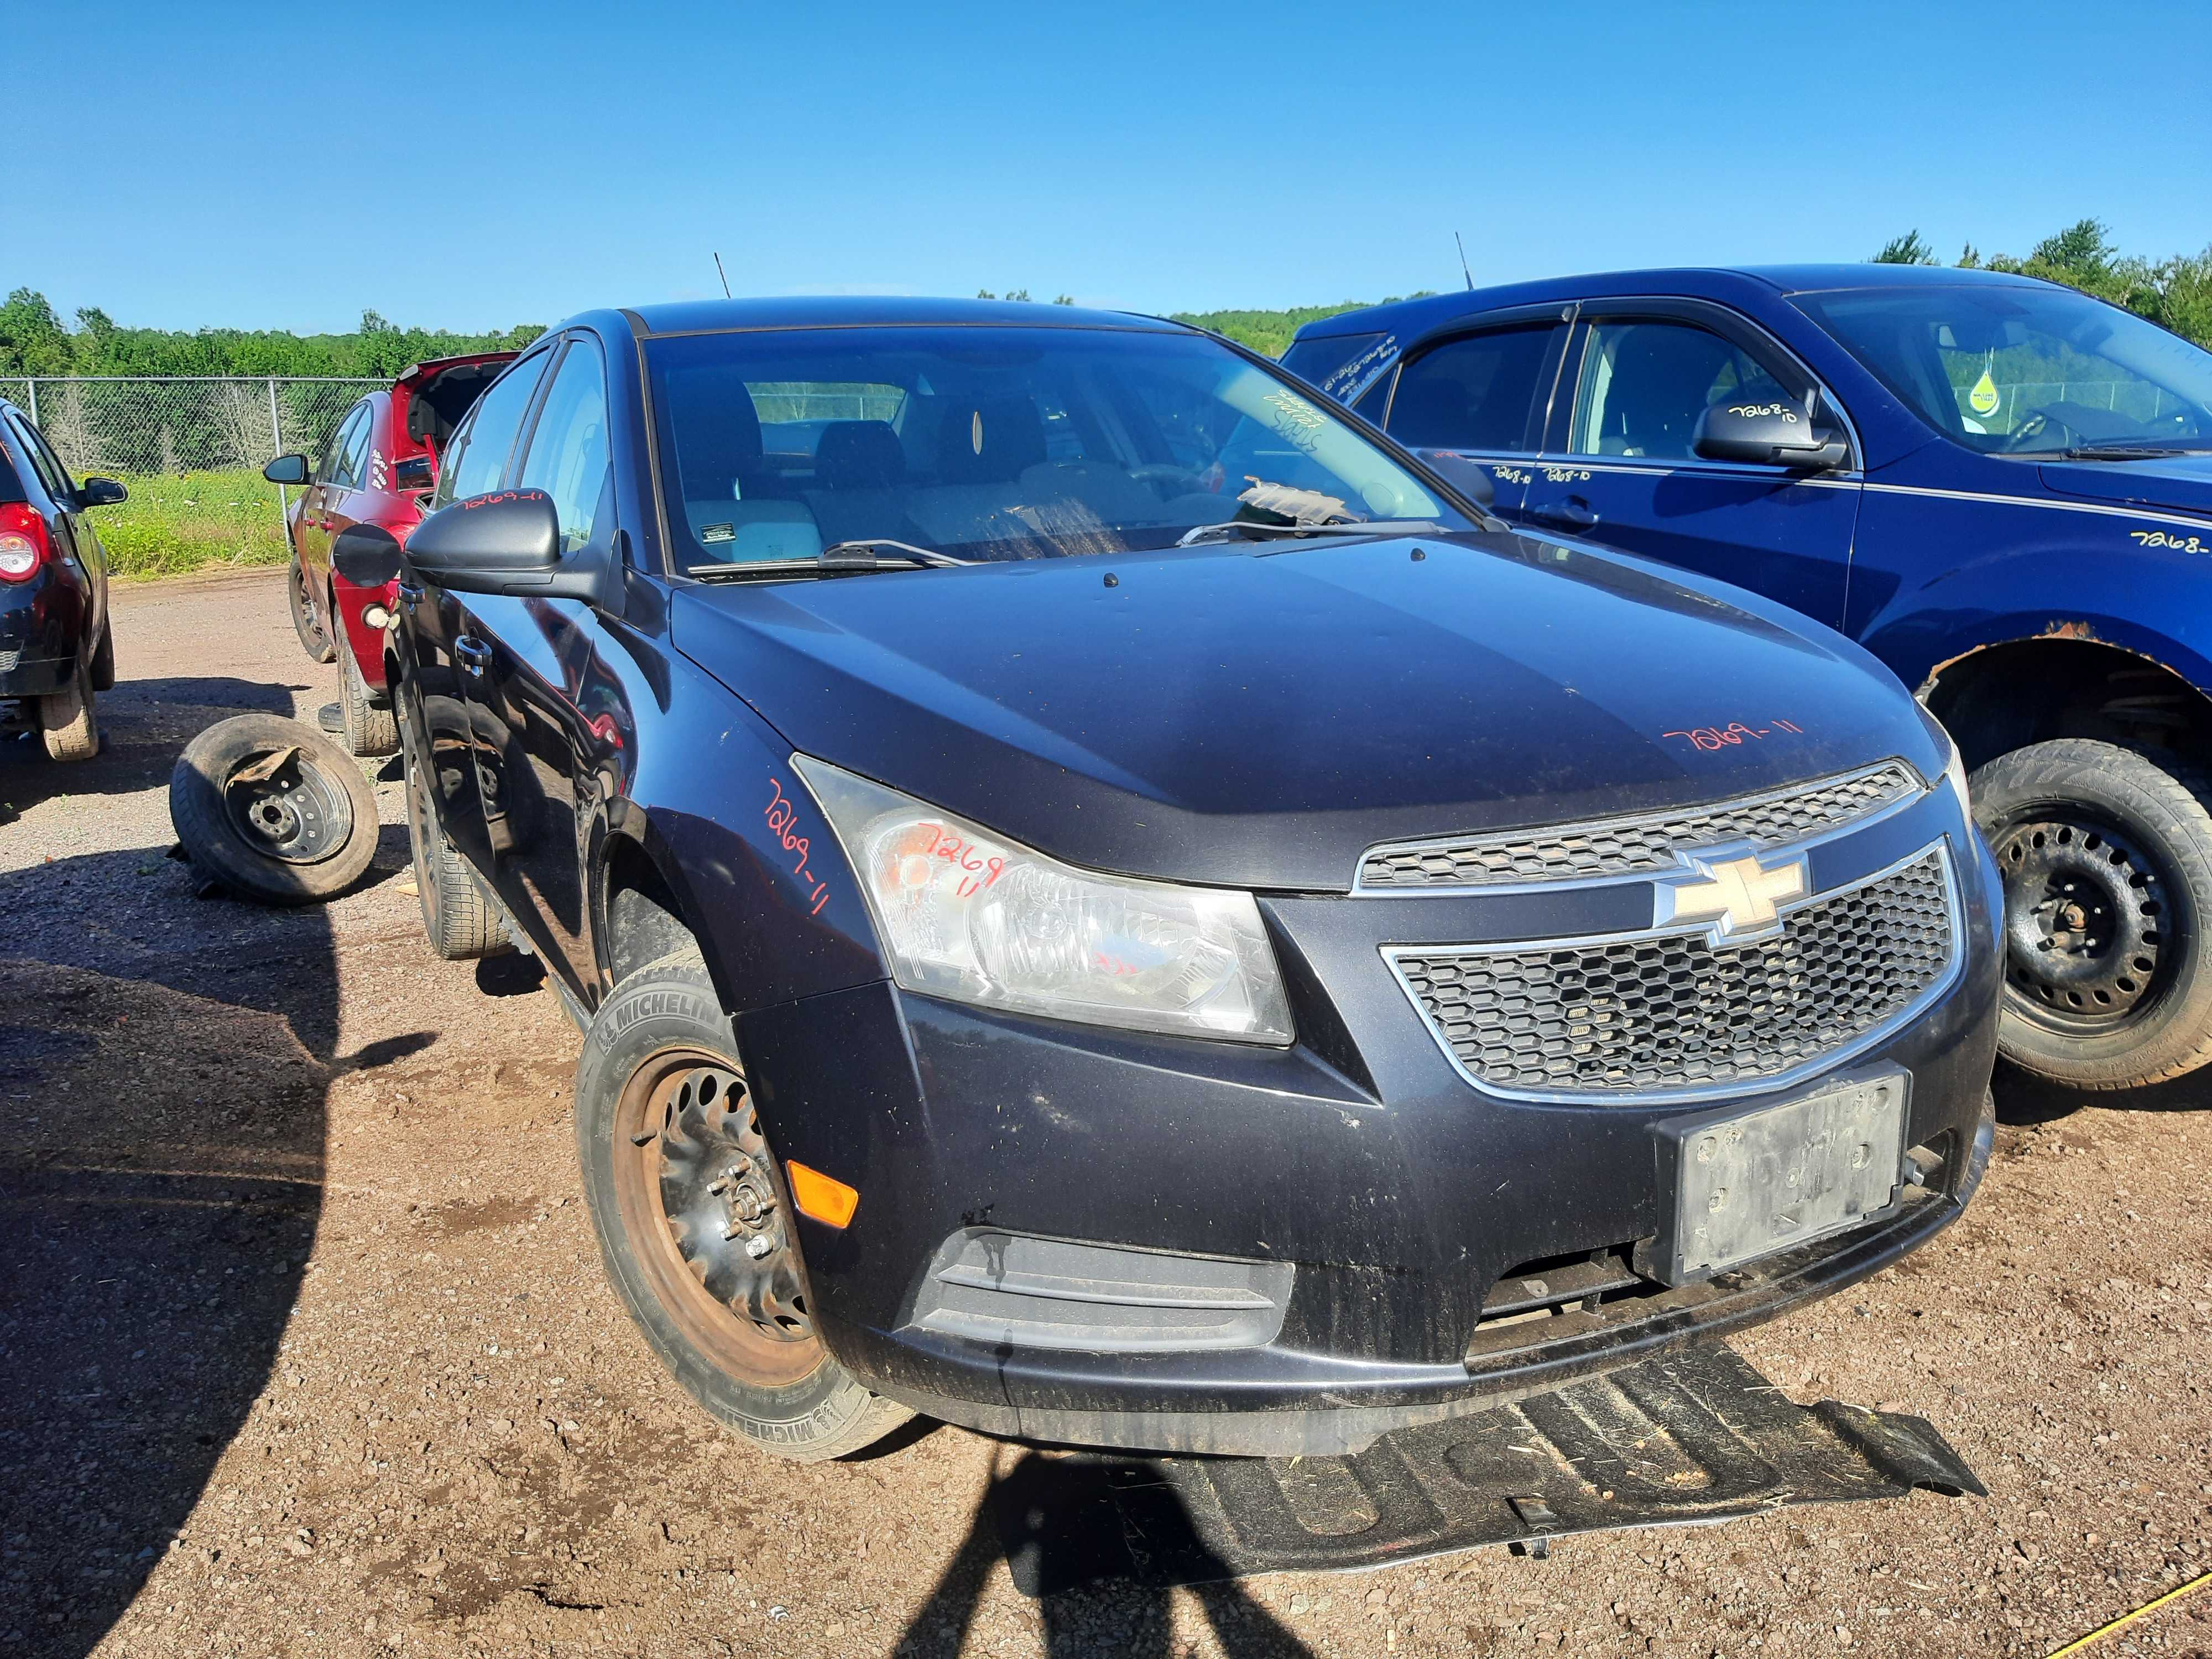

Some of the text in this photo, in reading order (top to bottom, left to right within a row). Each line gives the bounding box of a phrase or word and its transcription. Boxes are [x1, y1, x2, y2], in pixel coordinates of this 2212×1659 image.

[454, 492, 544, 510] 7269-11
[2130, 531, 2212, 557] 7268-
[765, 778, 829, 915] 7269-11
[918, 822, 1003, 888] 7269
[615, 994, 718, 1031] MICHELIN
